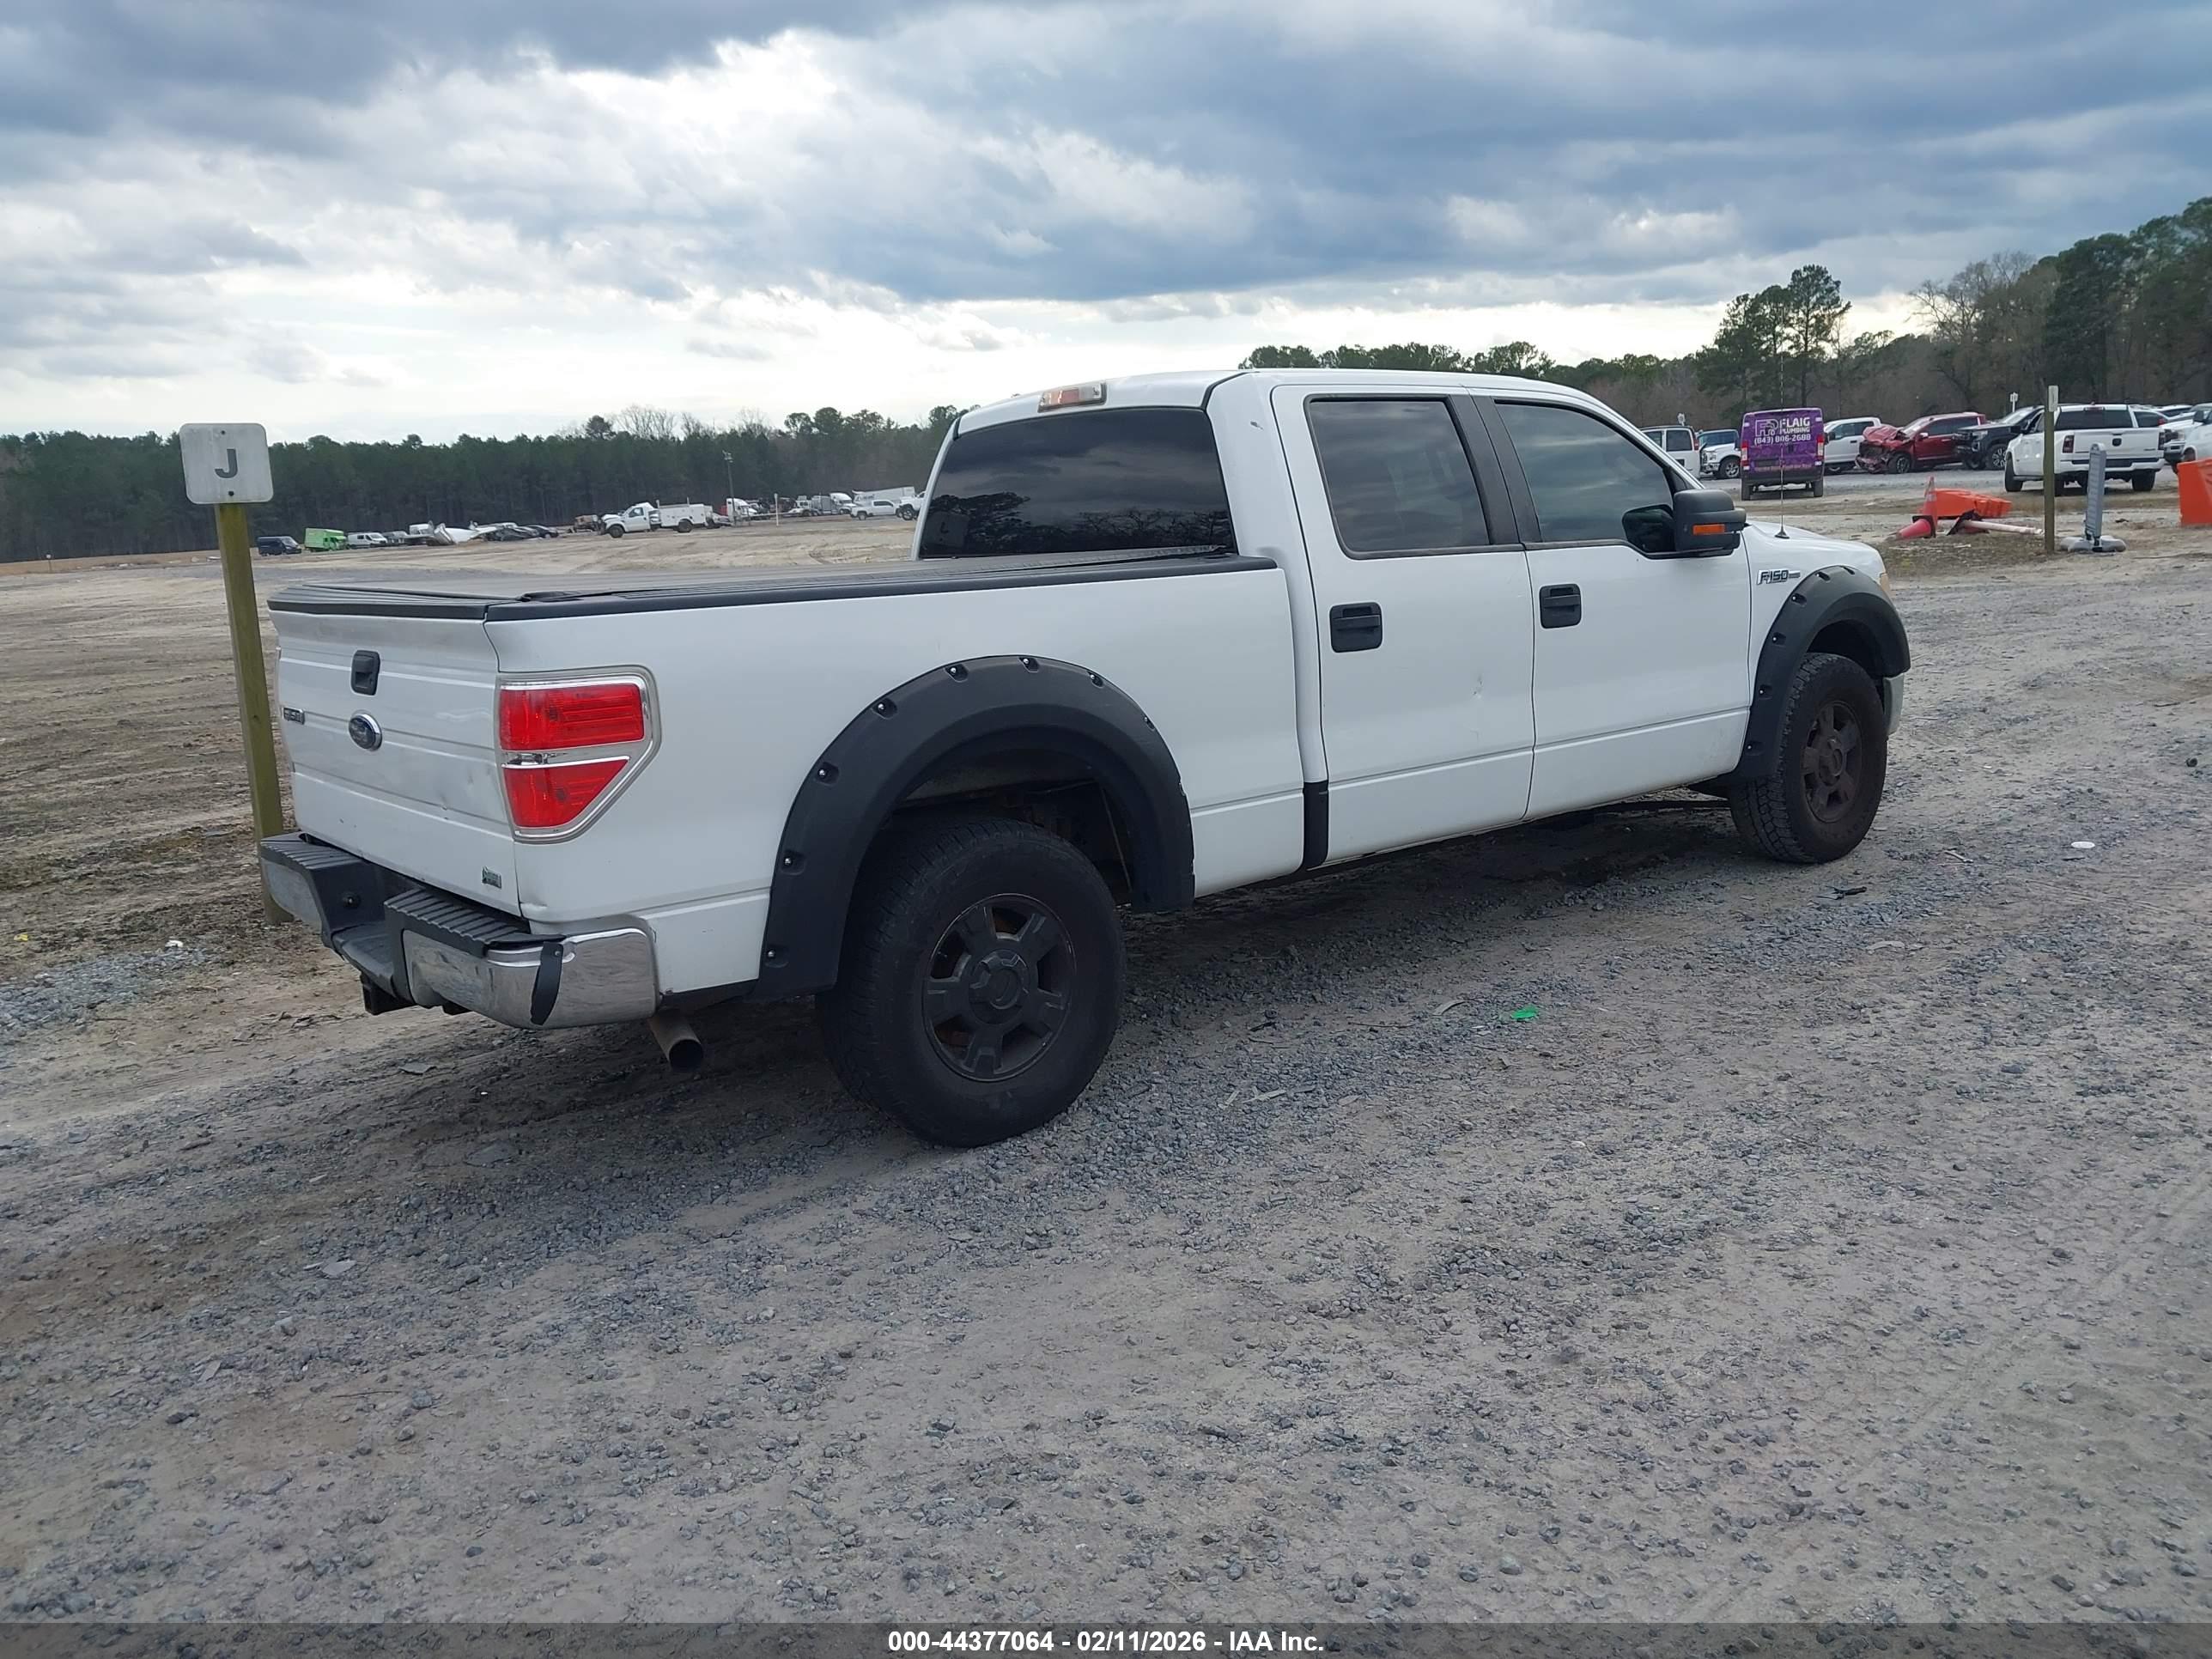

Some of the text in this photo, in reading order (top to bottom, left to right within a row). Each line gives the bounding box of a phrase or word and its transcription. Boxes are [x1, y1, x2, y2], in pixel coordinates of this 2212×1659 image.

[1779, 416, 1810, 429] FLAIG
[1754, 436, 1774, 446] (843)
[214, 448, 238, 478] J
